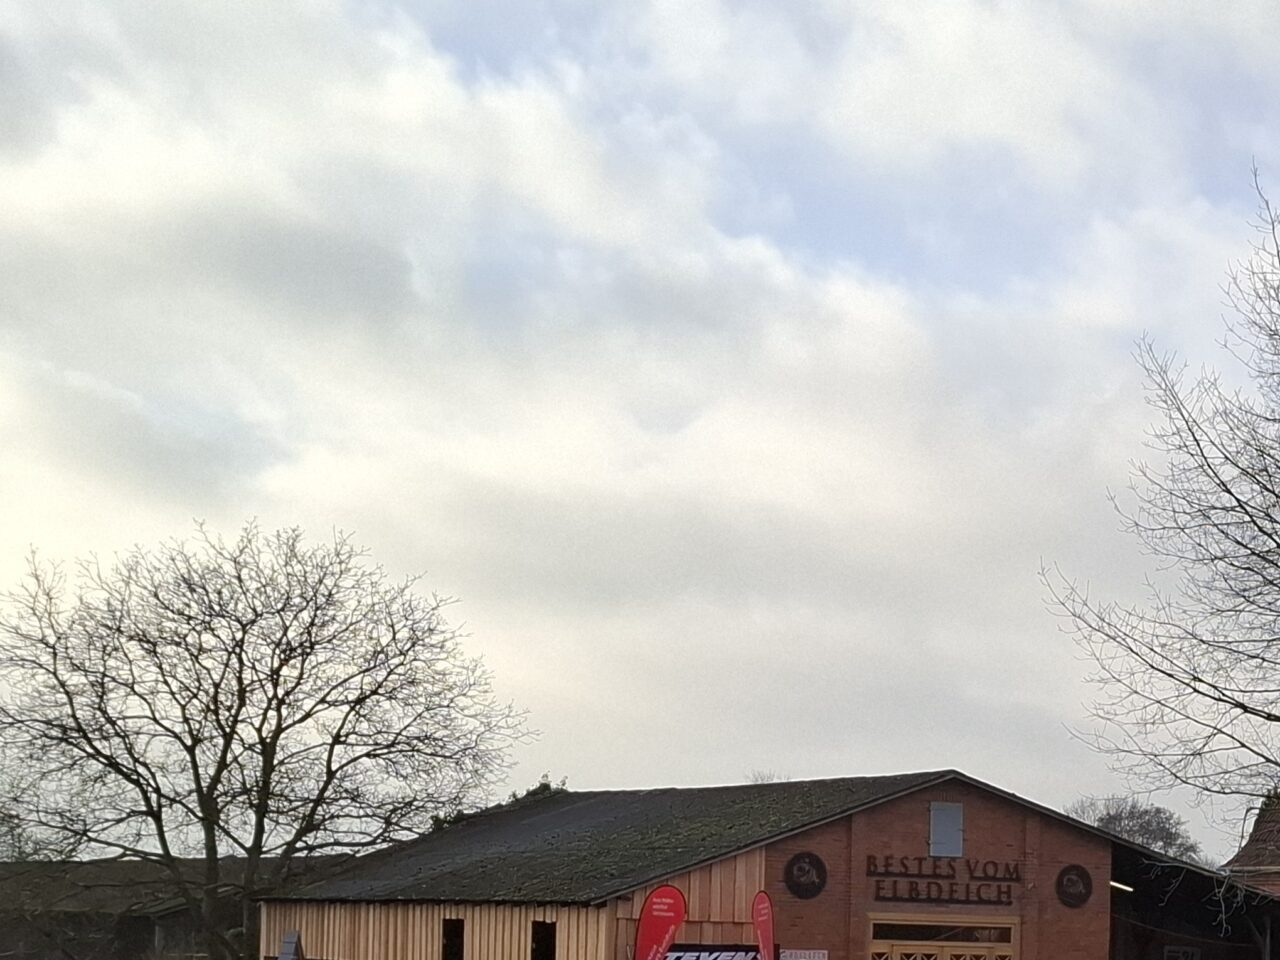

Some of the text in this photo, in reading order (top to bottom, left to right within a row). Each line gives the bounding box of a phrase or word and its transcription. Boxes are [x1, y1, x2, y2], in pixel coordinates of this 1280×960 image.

[866, 855, 1020, 880] BESTES VOM
[875, 880, 1013, 903] ELBDEICH
